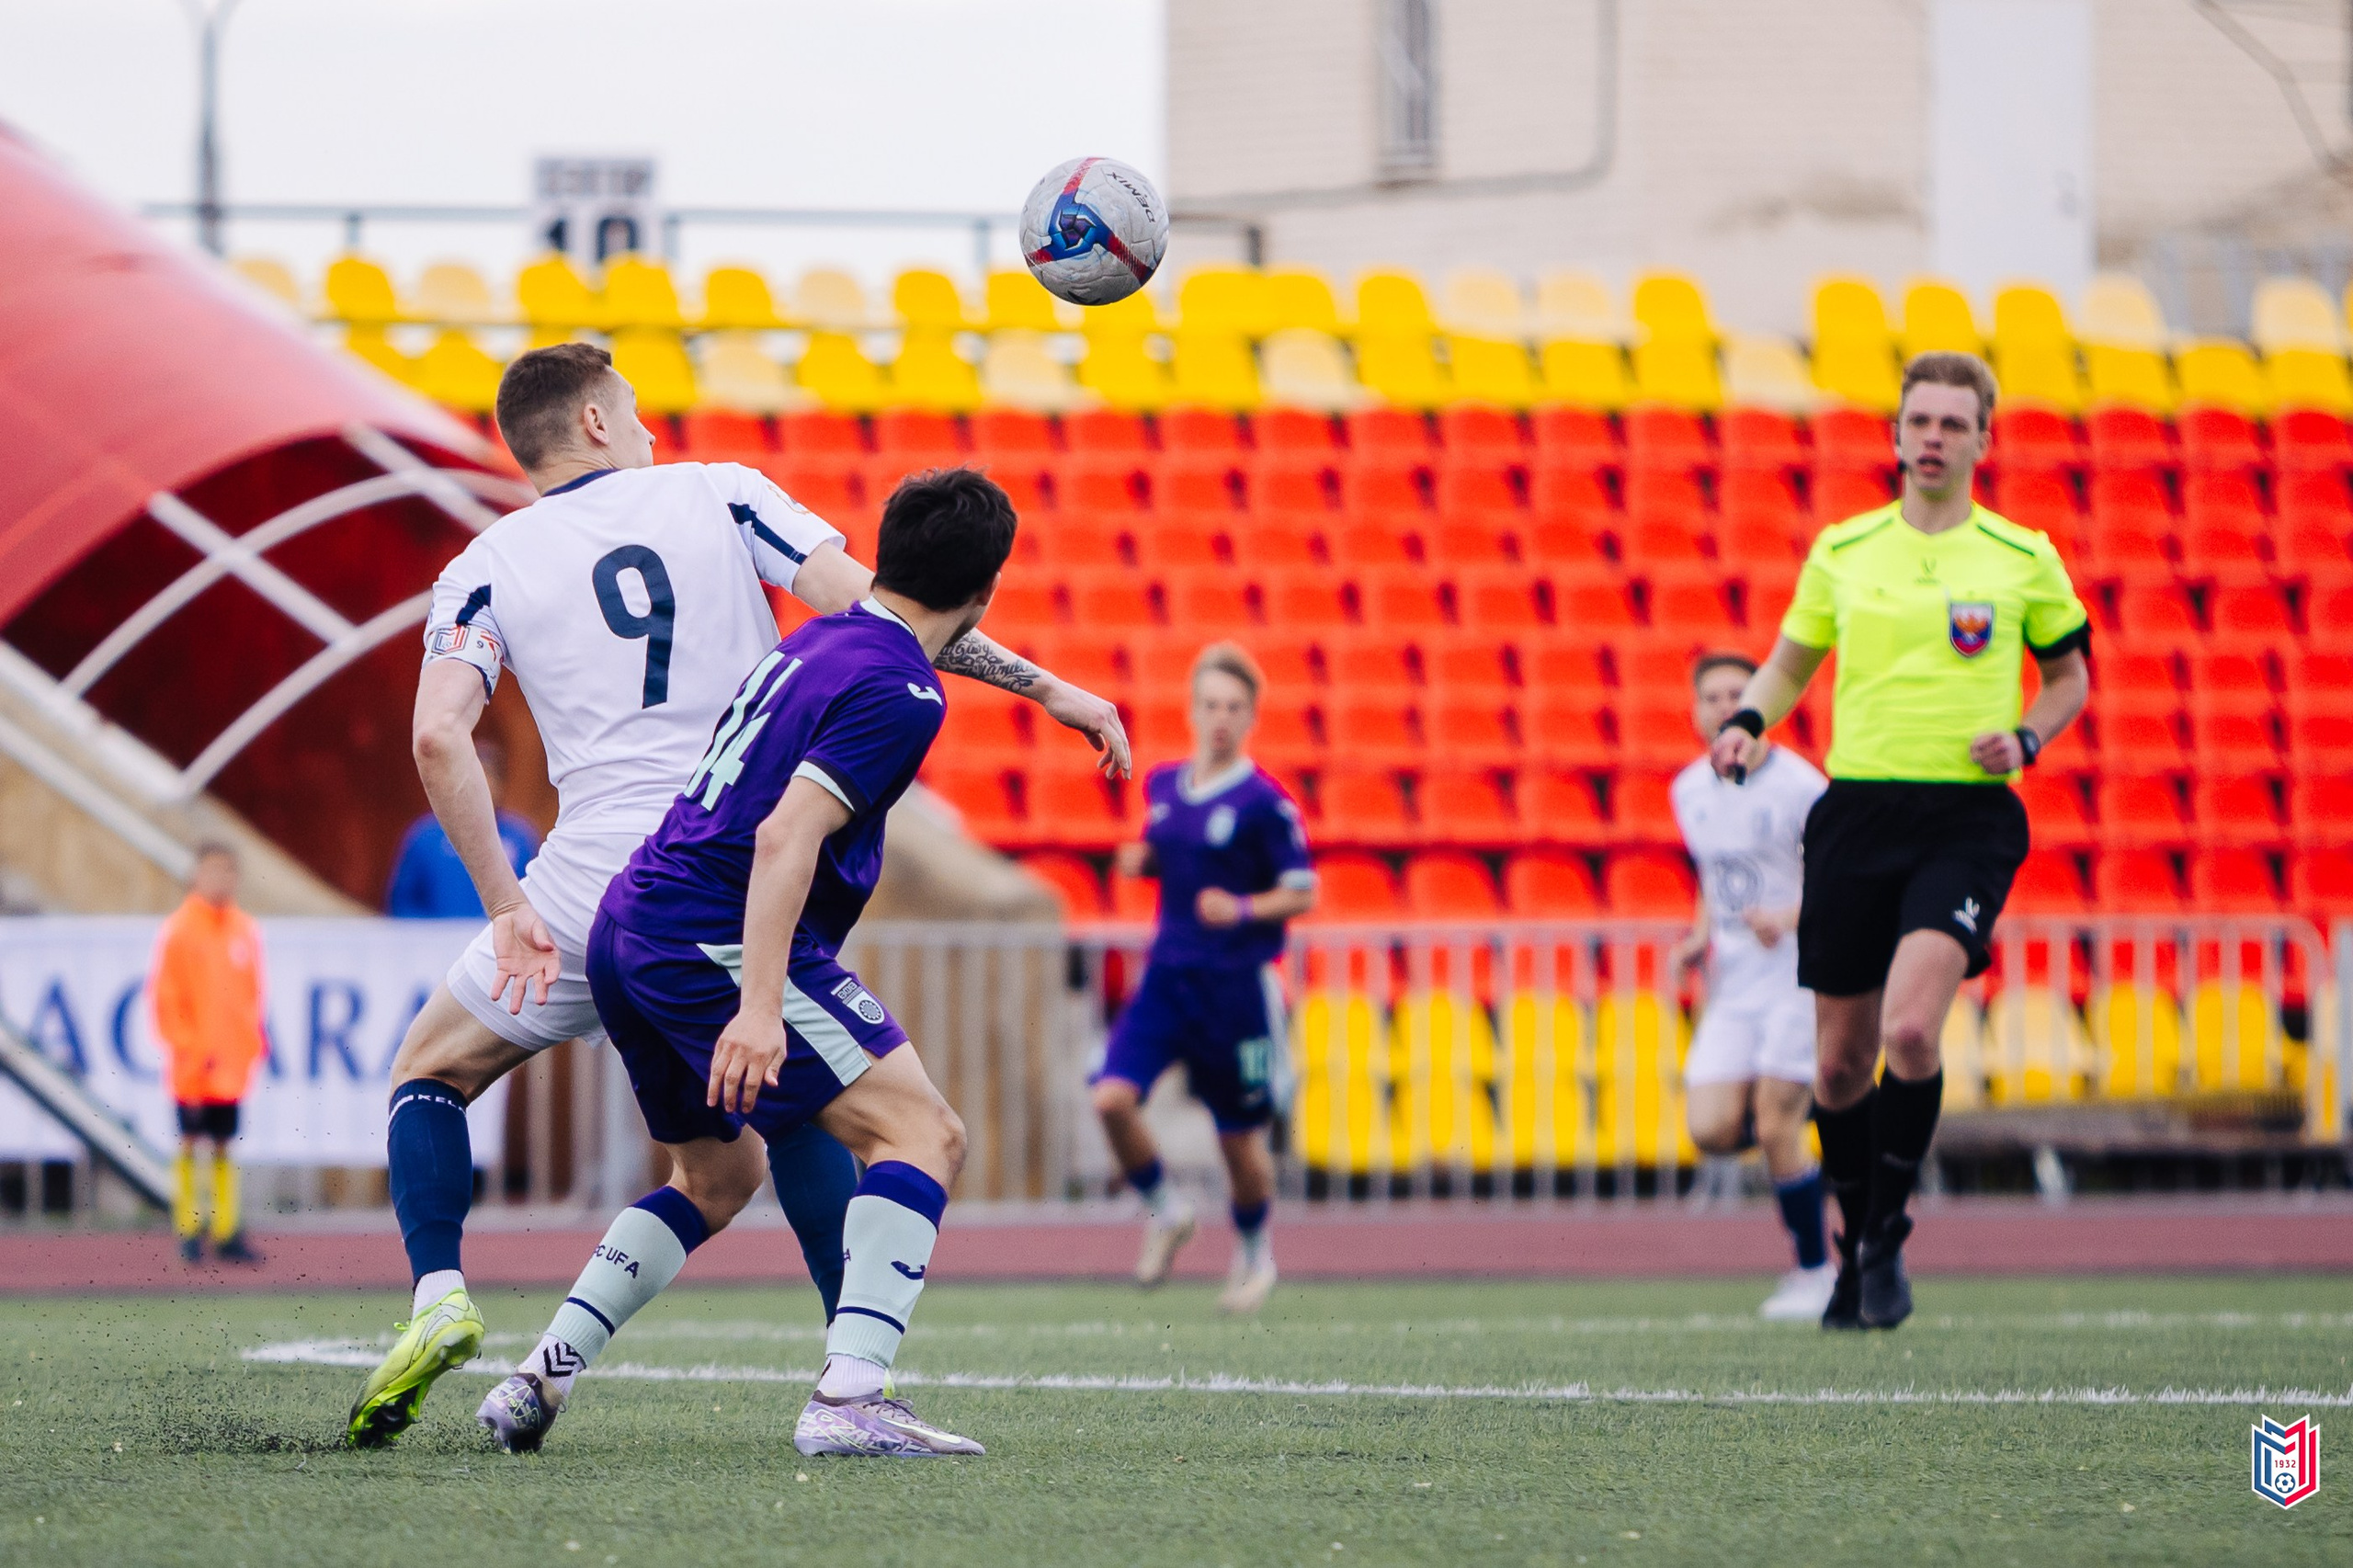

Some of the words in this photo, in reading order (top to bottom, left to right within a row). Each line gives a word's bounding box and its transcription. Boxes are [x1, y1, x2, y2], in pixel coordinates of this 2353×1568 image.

[1106, 172, 1155, 222] DEMIX
[592, 544, 676, 709] 9
[683, 650, 803, 812] 14
[606, 1246, 640, 1279] UFA
